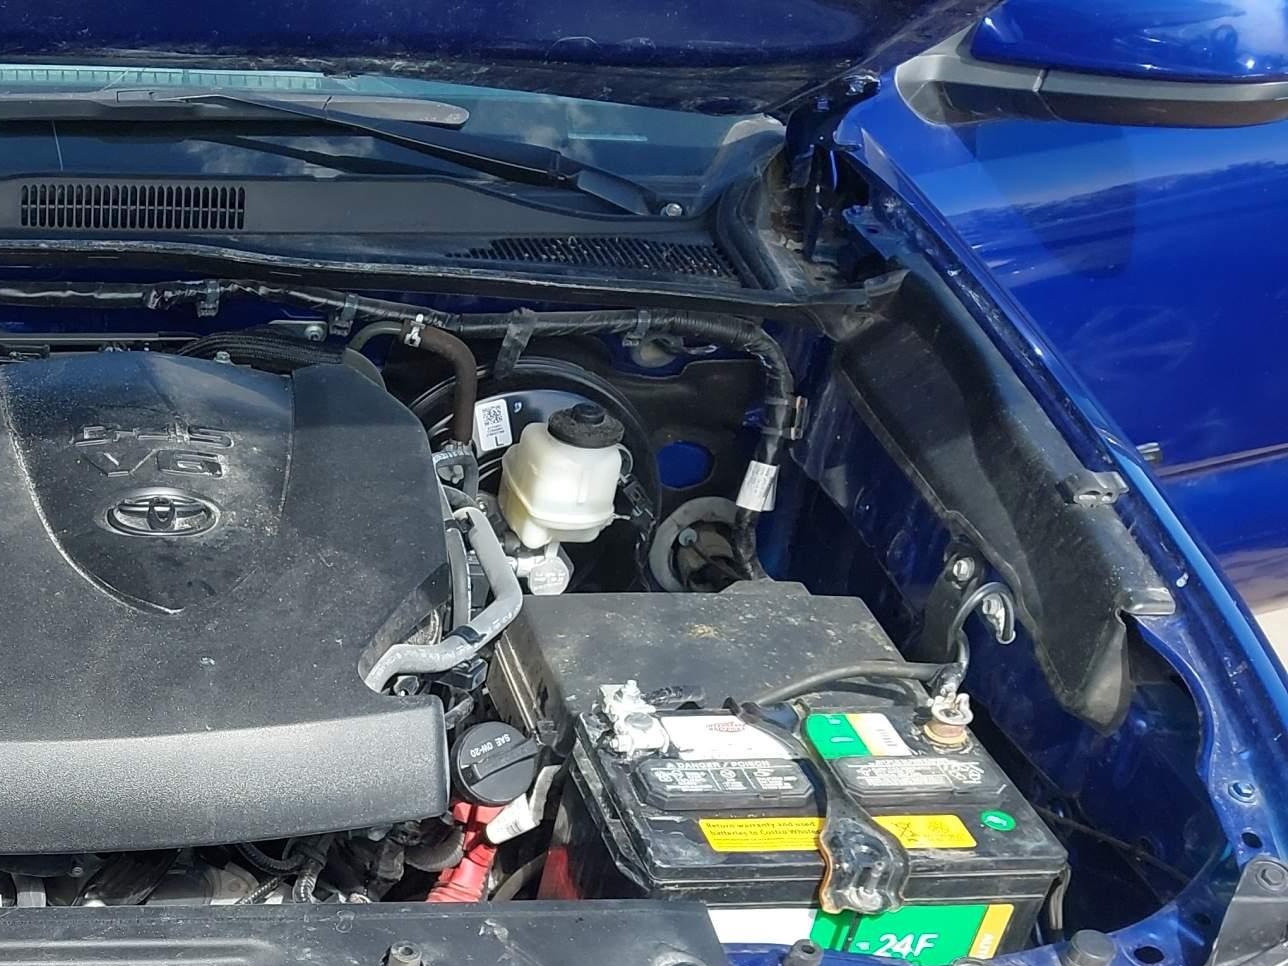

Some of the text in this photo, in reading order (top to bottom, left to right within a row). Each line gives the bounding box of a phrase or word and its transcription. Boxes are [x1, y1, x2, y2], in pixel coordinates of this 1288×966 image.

[80, 447, 229, 479] V6
[470, 733, 511, 758] SAE 0W-20
[731, 760, 770, 768] POISON
[737, 822, 776, 830] warranty
[872, 933, 939, 958] 24F
